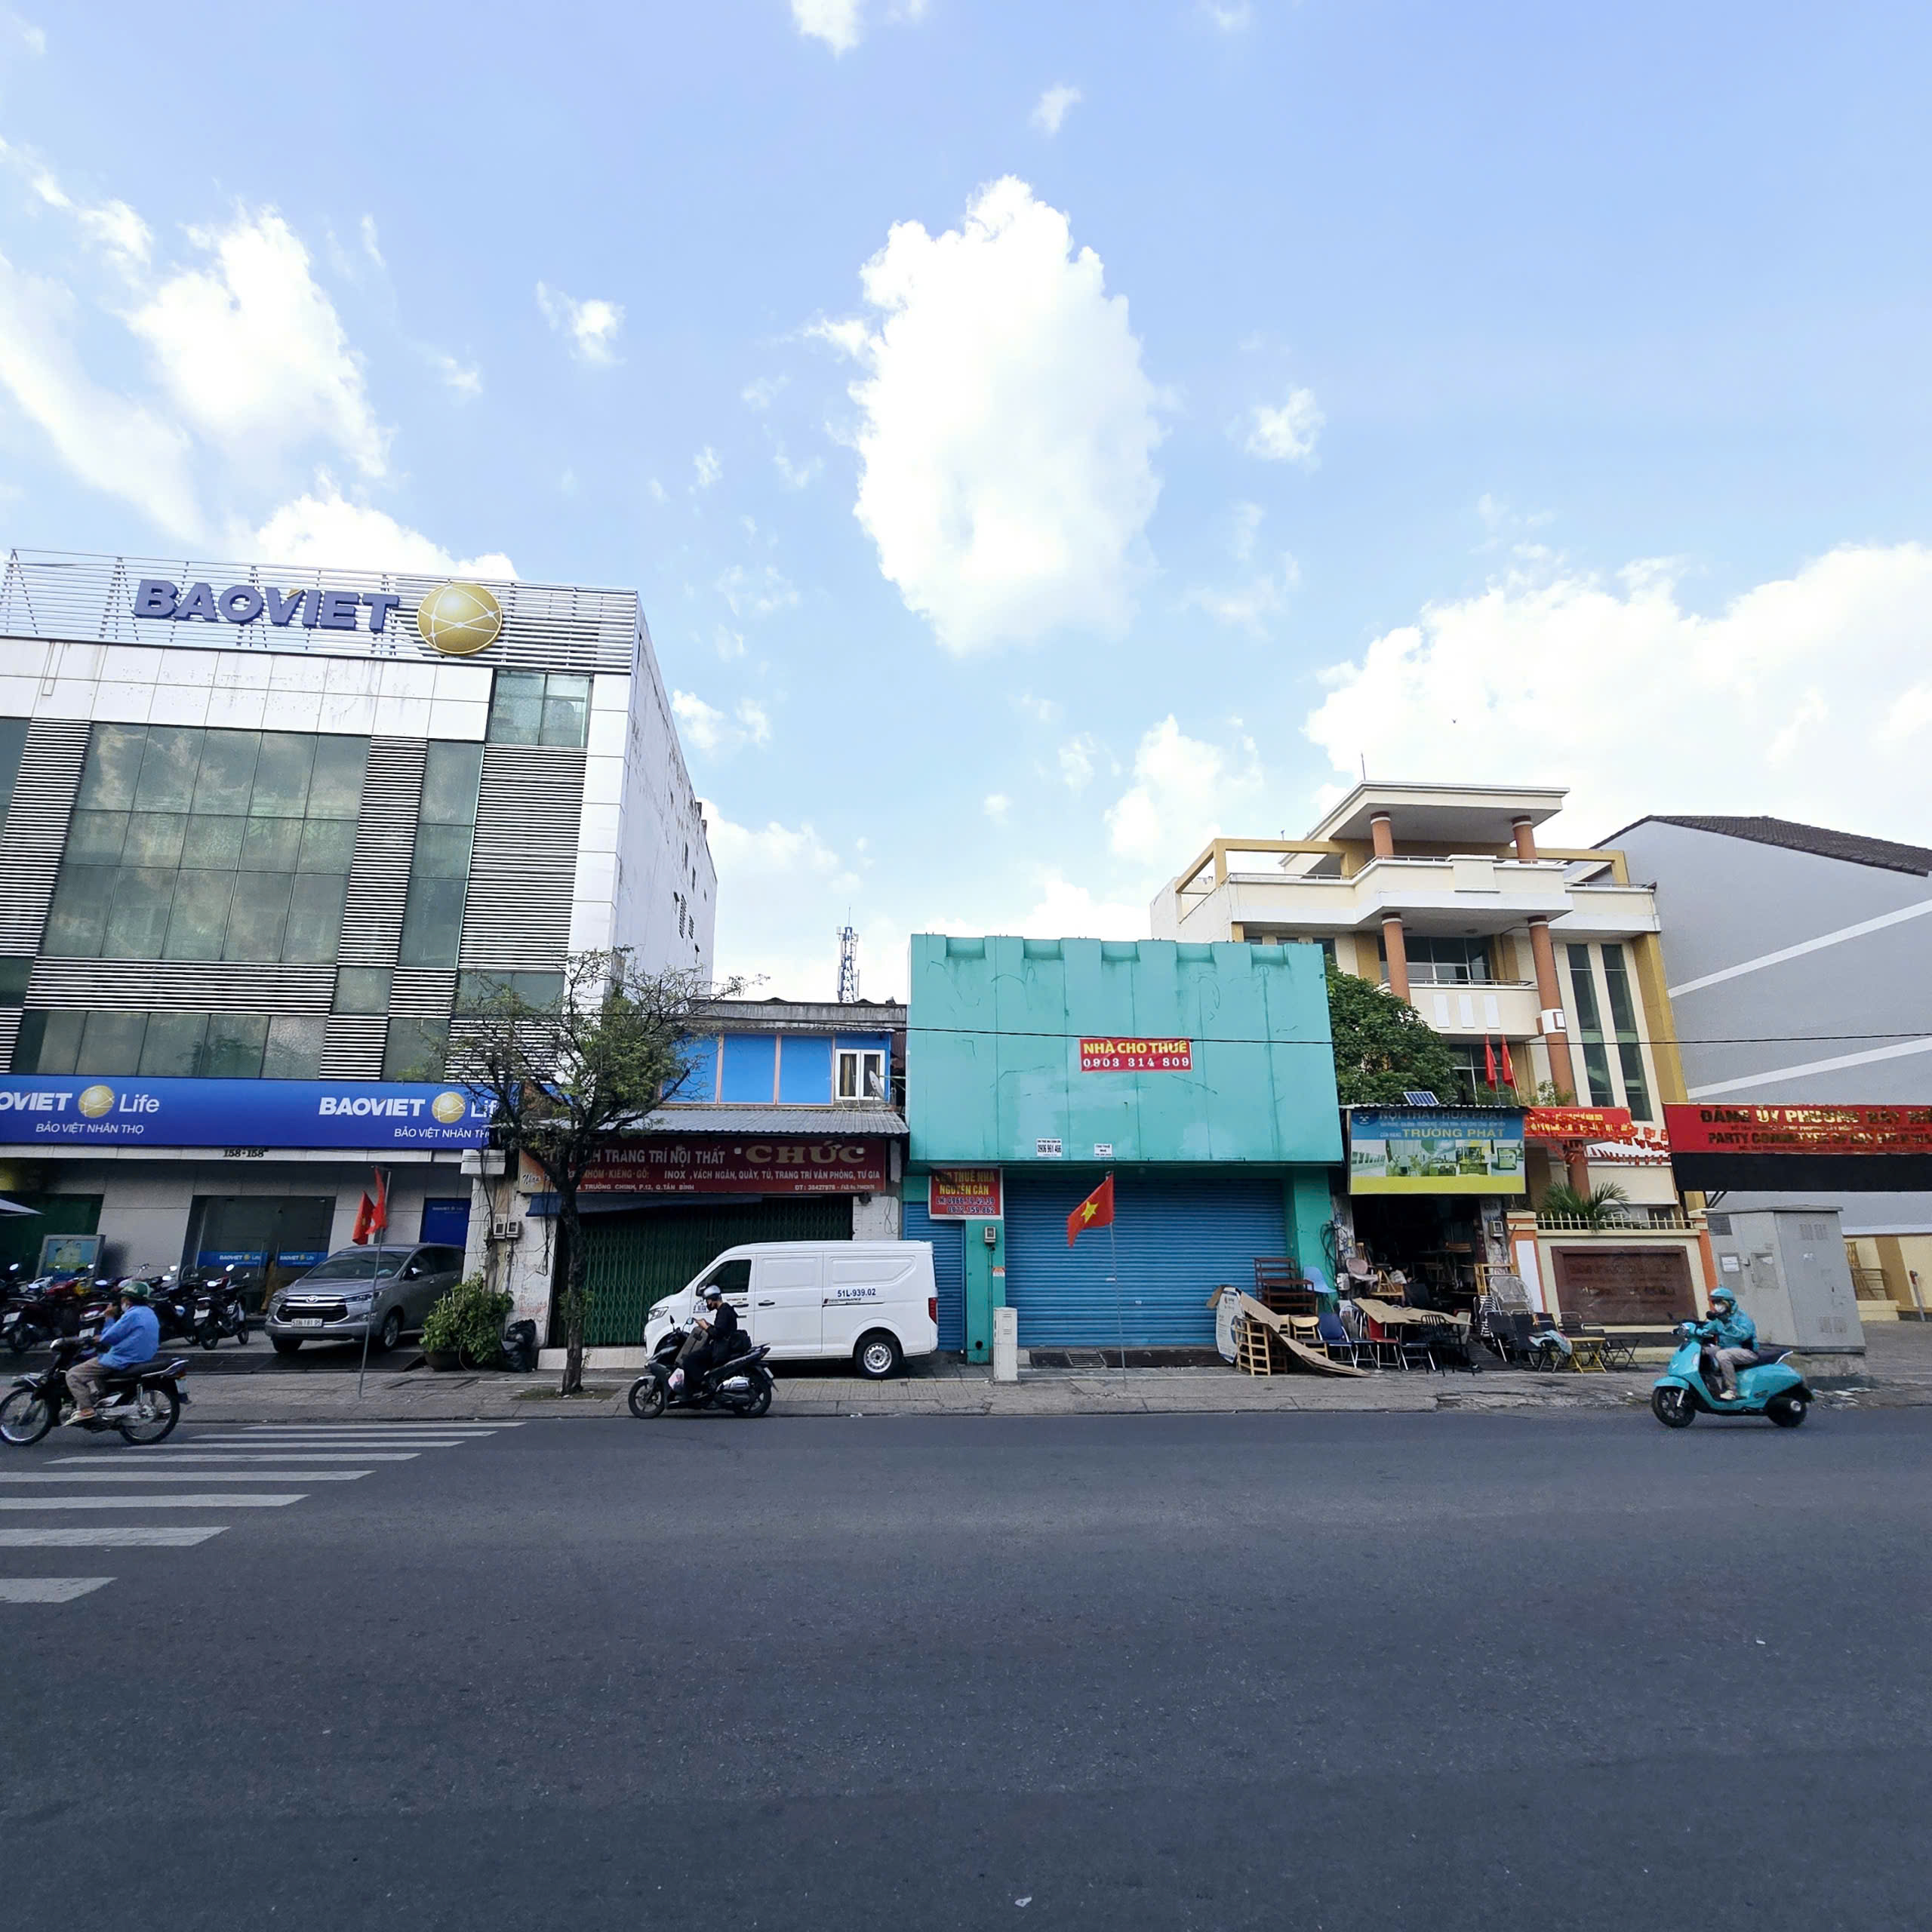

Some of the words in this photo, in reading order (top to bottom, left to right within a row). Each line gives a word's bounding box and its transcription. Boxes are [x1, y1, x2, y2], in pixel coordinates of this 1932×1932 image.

[131, 579, 399, 633] BAOVIET
[1083, 1039, 1115, 1054] NHÀ
[1117, 1042, 1147, 1054] CHO
[1149, 1040, 1187, 1054] THUÊ
[1083, 1057, 1119, 1067] 0903
[1128, 1057, 1155, 1067] 314
[1162, 1057, 1189, 1067] 809
[119, 1094, 160, 1113] Life
[318, 1097, 426, 1117] BAOVIET
[35, 1121, 60, 1133] BẢO
[63, 1122, 85, 1134] VIỆT
[87, 1122, 118, 1134] NHÂN
[121, 1124, 144, 1134] THỌ
[394, 1126, 417, 1138] BẢO
[418, 1127, 440, 1139] VIỆT
[441, 1127, 472, 1138] NHÂN
[605, 1149, 645, 1163] TRANG
[649, 1146, 668, 1163] TRÍ
[670, 1146, 691, 1168] NỘI
[695, 1146, 725, 1164] THẤT
[746, 1141, 866, 1164] CHỨC
[664, 1171, 686, 1180] INOX
[775, 1171, 798, 1180] TRANG
[801, 1169, 812, 1180] TRÍ
[869, 1171, 880, 1180] GIA
[837, 1288, 876, 1298] 51L-939.02
